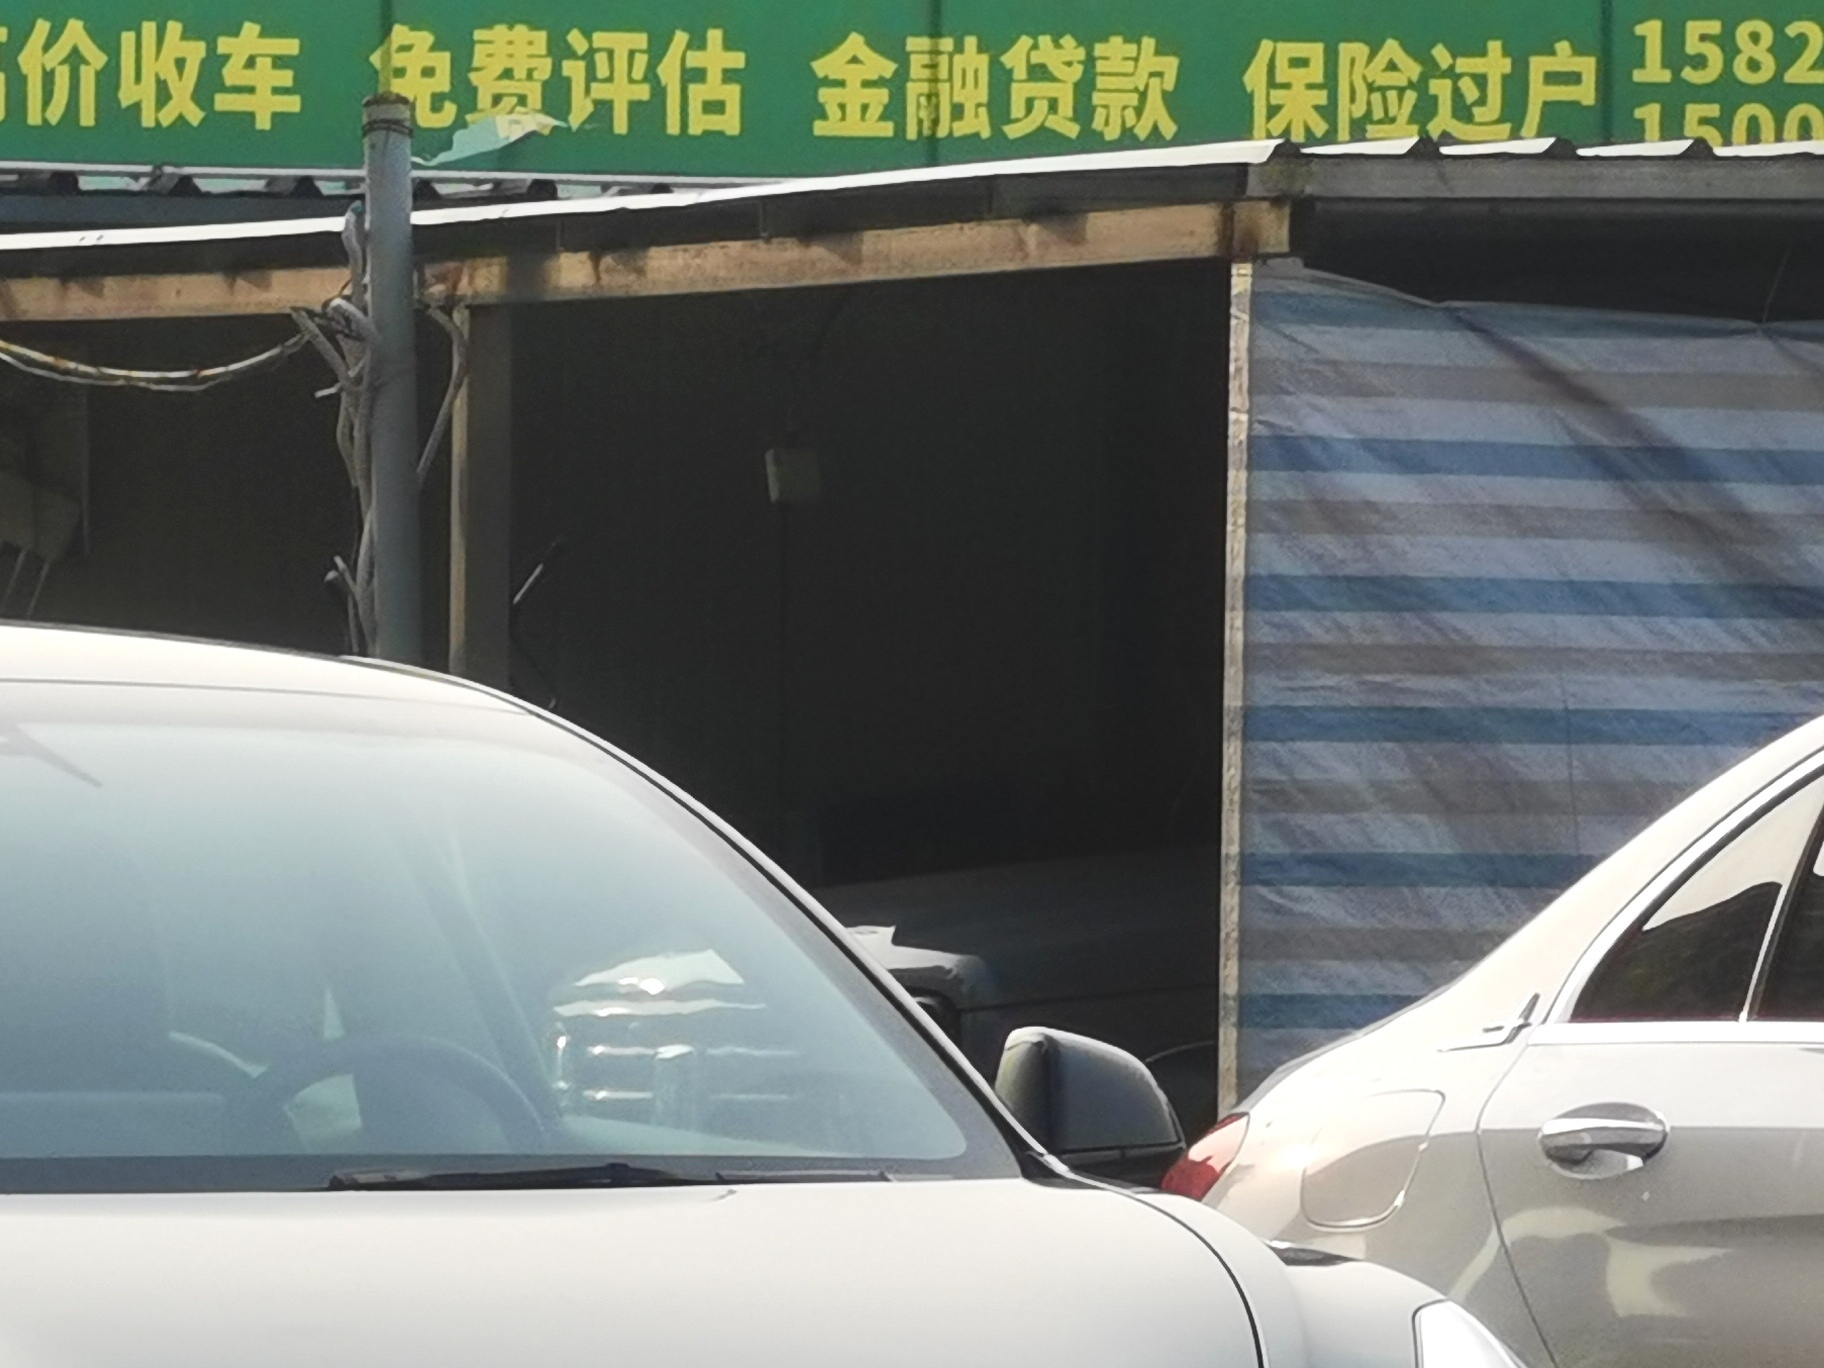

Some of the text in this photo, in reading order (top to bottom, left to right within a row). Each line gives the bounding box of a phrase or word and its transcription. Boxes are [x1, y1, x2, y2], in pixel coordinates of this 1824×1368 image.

[369, 24, 746, 136] 免费评估
[810, 31, 1180, 141] 金融贷款
[1243, 38, 1597, 142] 保险过户
[1632, 18, 1824, 84] 1582
